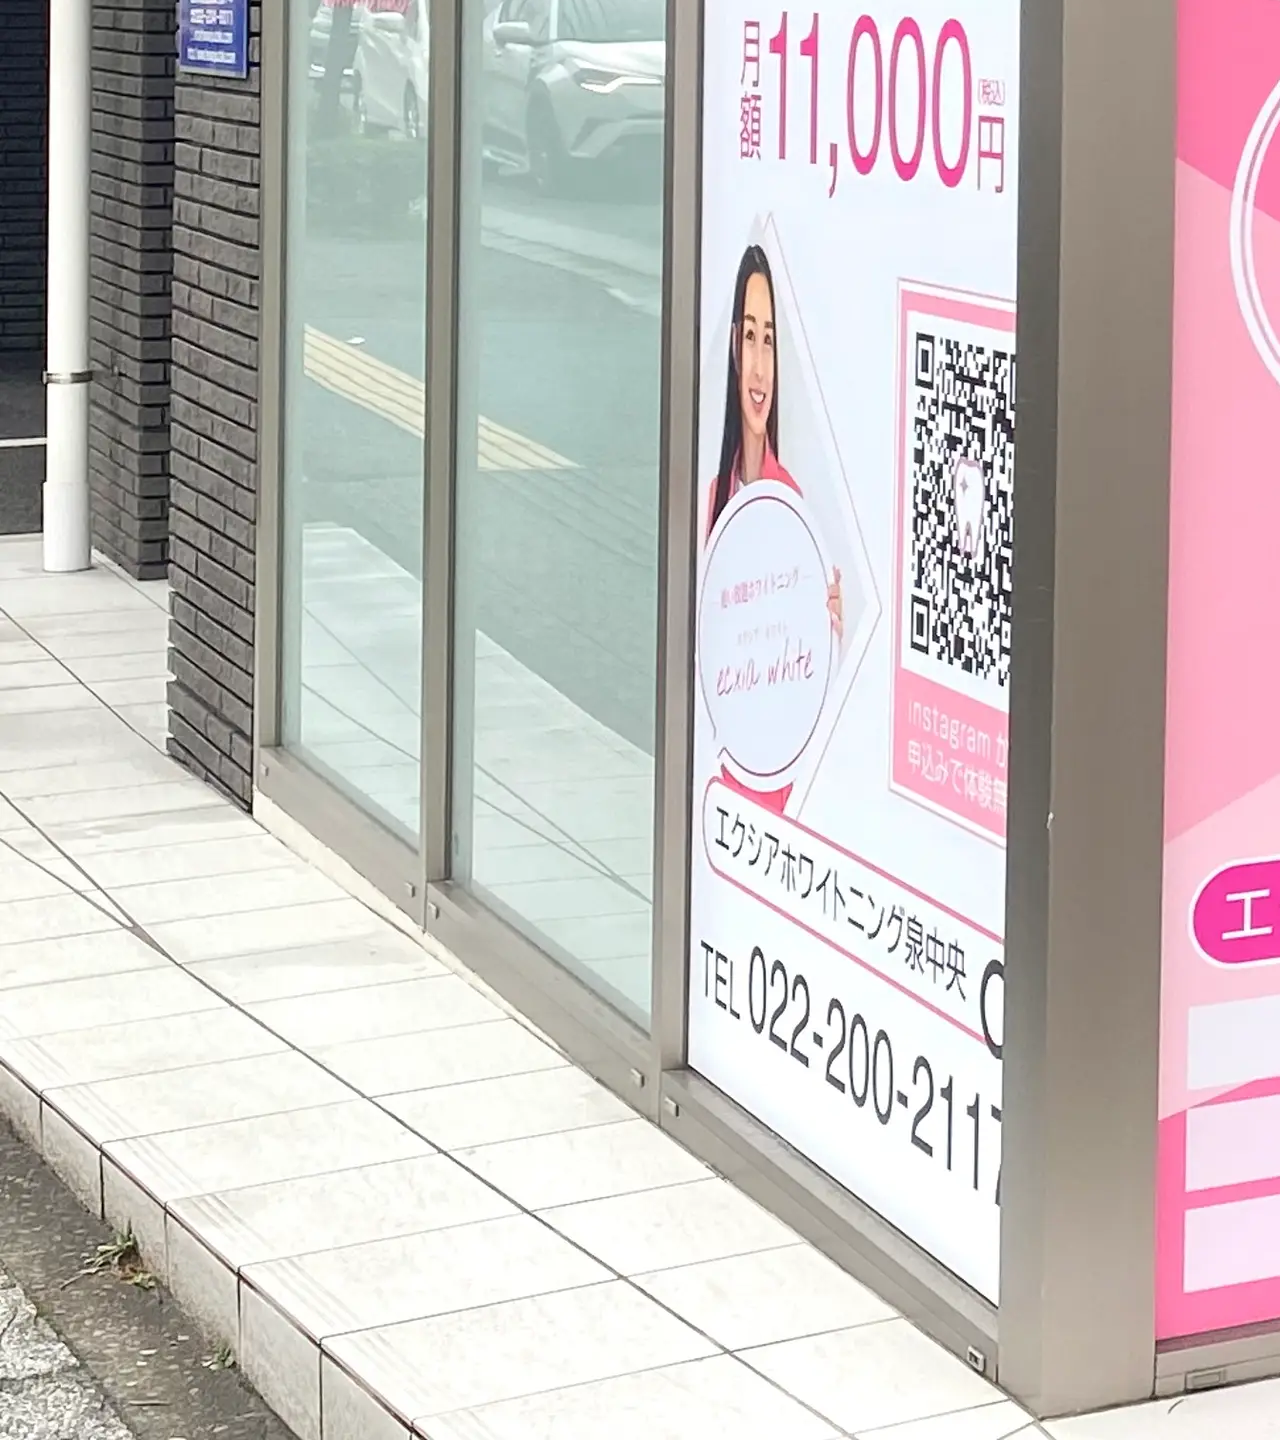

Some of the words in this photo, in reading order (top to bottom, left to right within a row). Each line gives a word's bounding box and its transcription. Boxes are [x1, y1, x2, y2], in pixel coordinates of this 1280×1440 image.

[716, 805, 967, 1002] エクシアホワイトニング泉中央
[700, 939, 741, 1021] TEL
